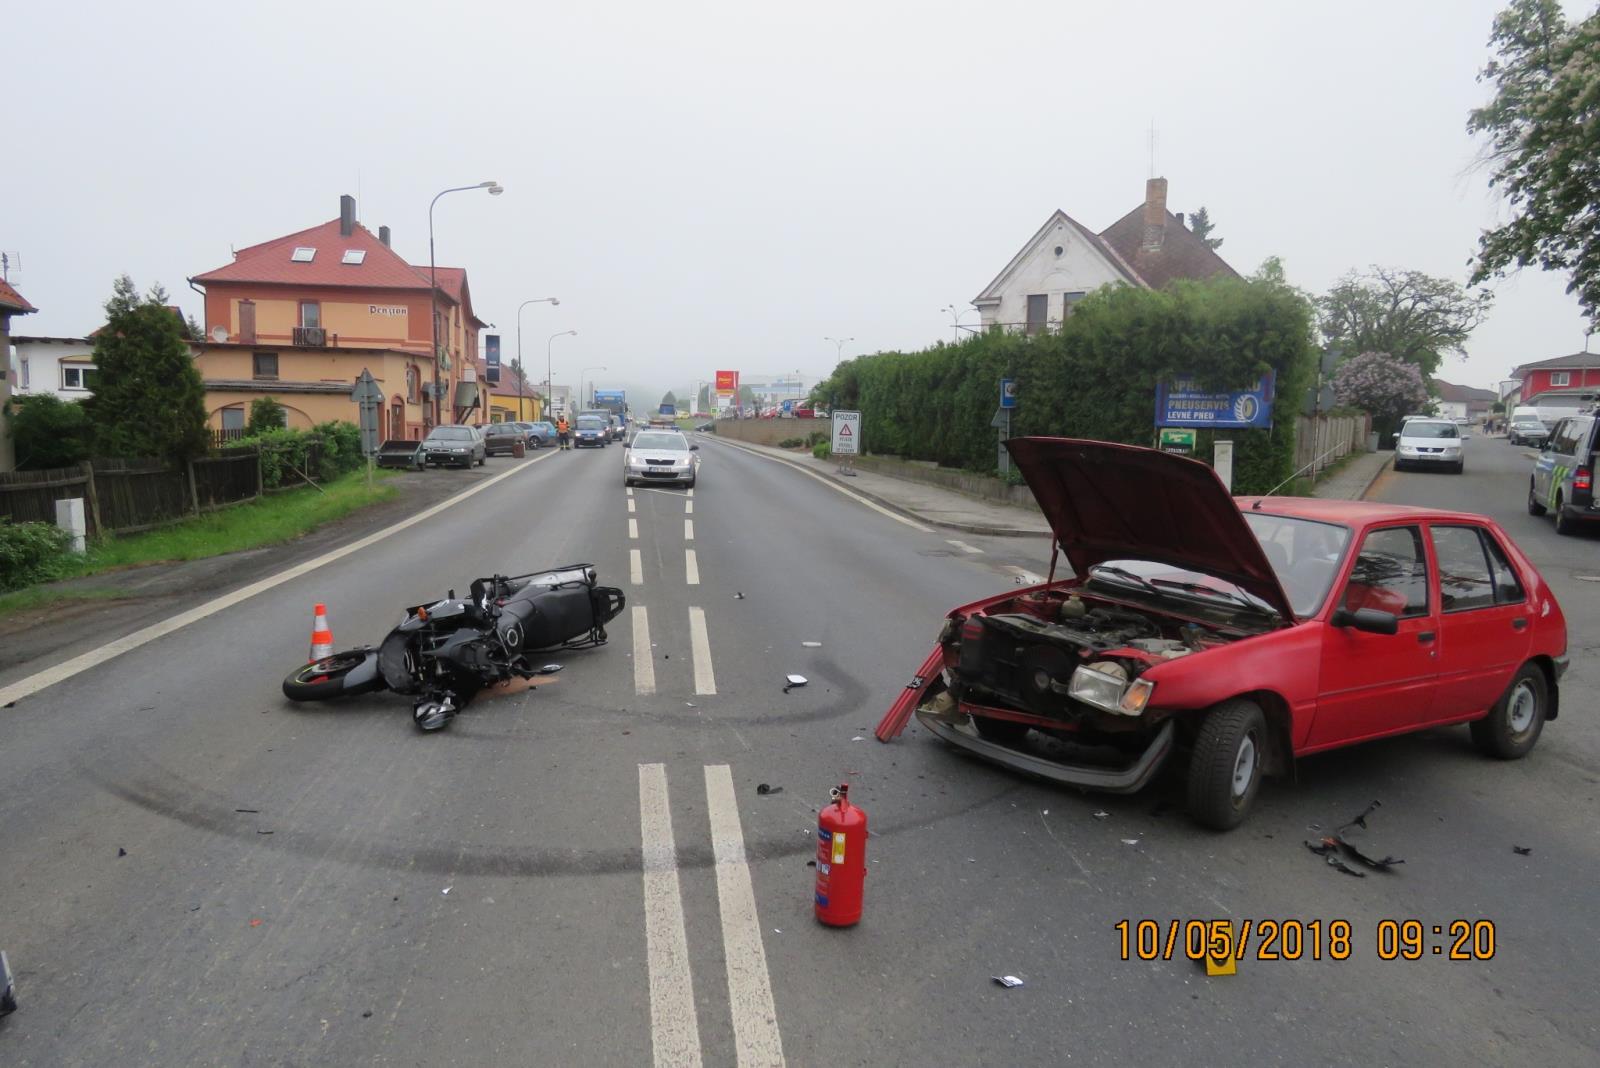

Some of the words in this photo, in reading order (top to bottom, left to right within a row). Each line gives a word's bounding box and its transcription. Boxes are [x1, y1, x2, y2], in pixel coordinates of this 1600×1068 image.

[1168, 400, 1229, 410] PNEUSERVIS
[836, 413, 857, 421] POZOR
[1193, 412, 1214, 420] PNEU
